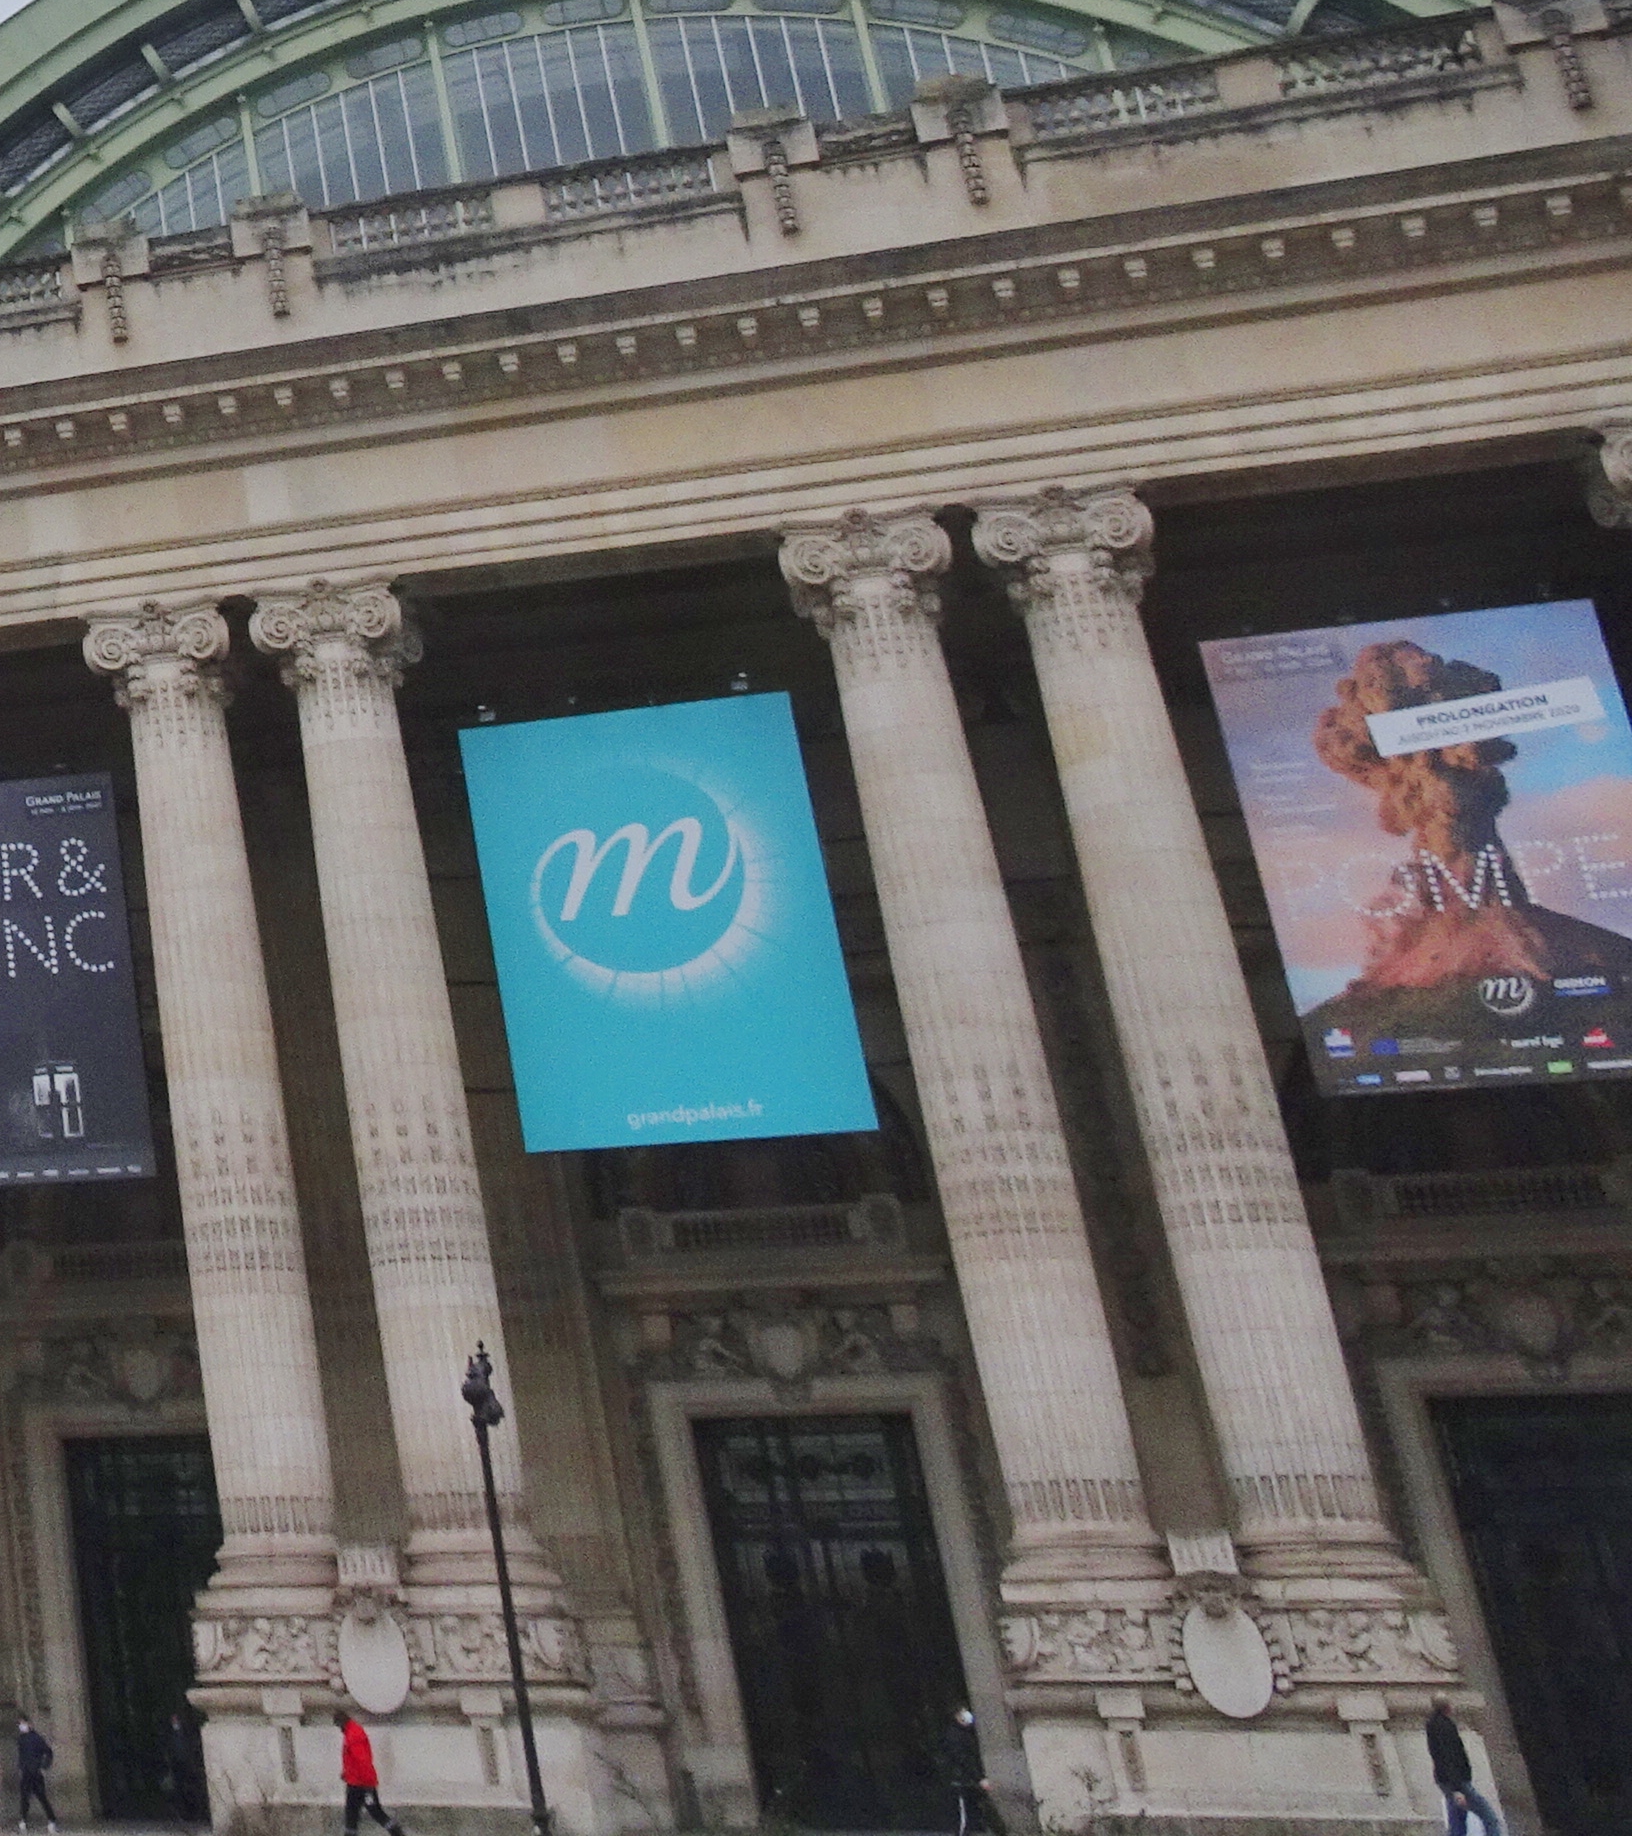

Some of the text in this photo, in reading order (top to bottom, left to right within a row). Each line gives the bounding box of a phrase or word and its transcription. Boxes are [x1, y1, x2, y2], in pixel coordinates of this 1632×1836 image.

[1416, 694, 1549, 728] PROLONGATION
[25, 790, 102, 807] GRAND PALAIS
[626, 1098, 763, 1130] grandpalais.fr
